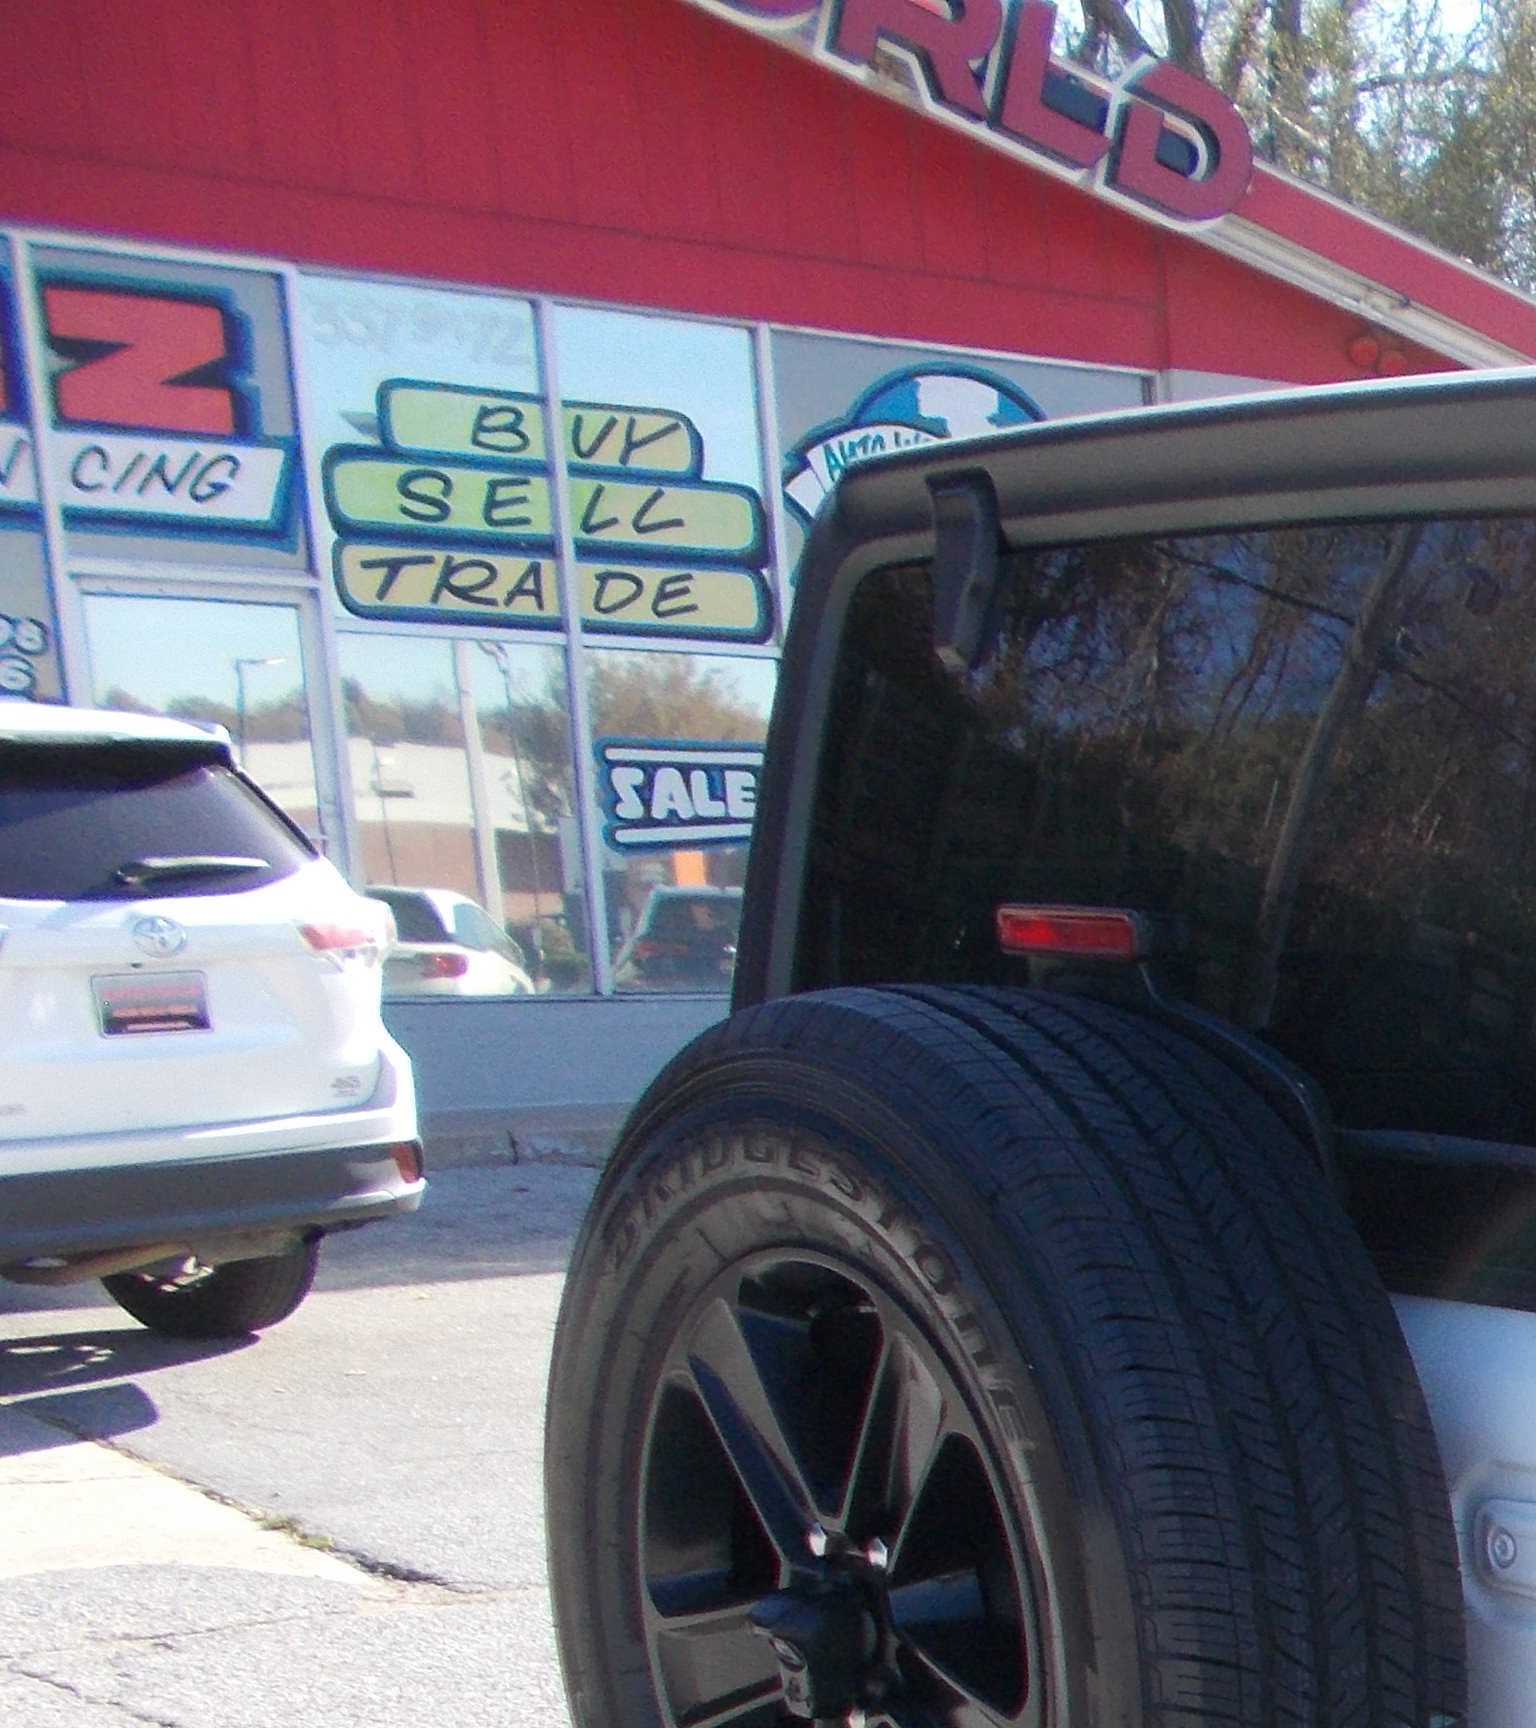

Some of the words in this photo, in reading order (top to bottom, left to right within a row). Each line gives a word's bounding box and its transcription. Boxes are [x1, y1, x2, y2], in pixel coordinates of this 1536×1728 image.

[690, 0, 1255, 224] RLD
[0, 286, 235, 436] Z
[472, 405, 682, 466] BUY
[397, 468, 686, 535] SELL
[360, 554, 699, 619] TRADE
[610, 766, 757, 820] SALE
